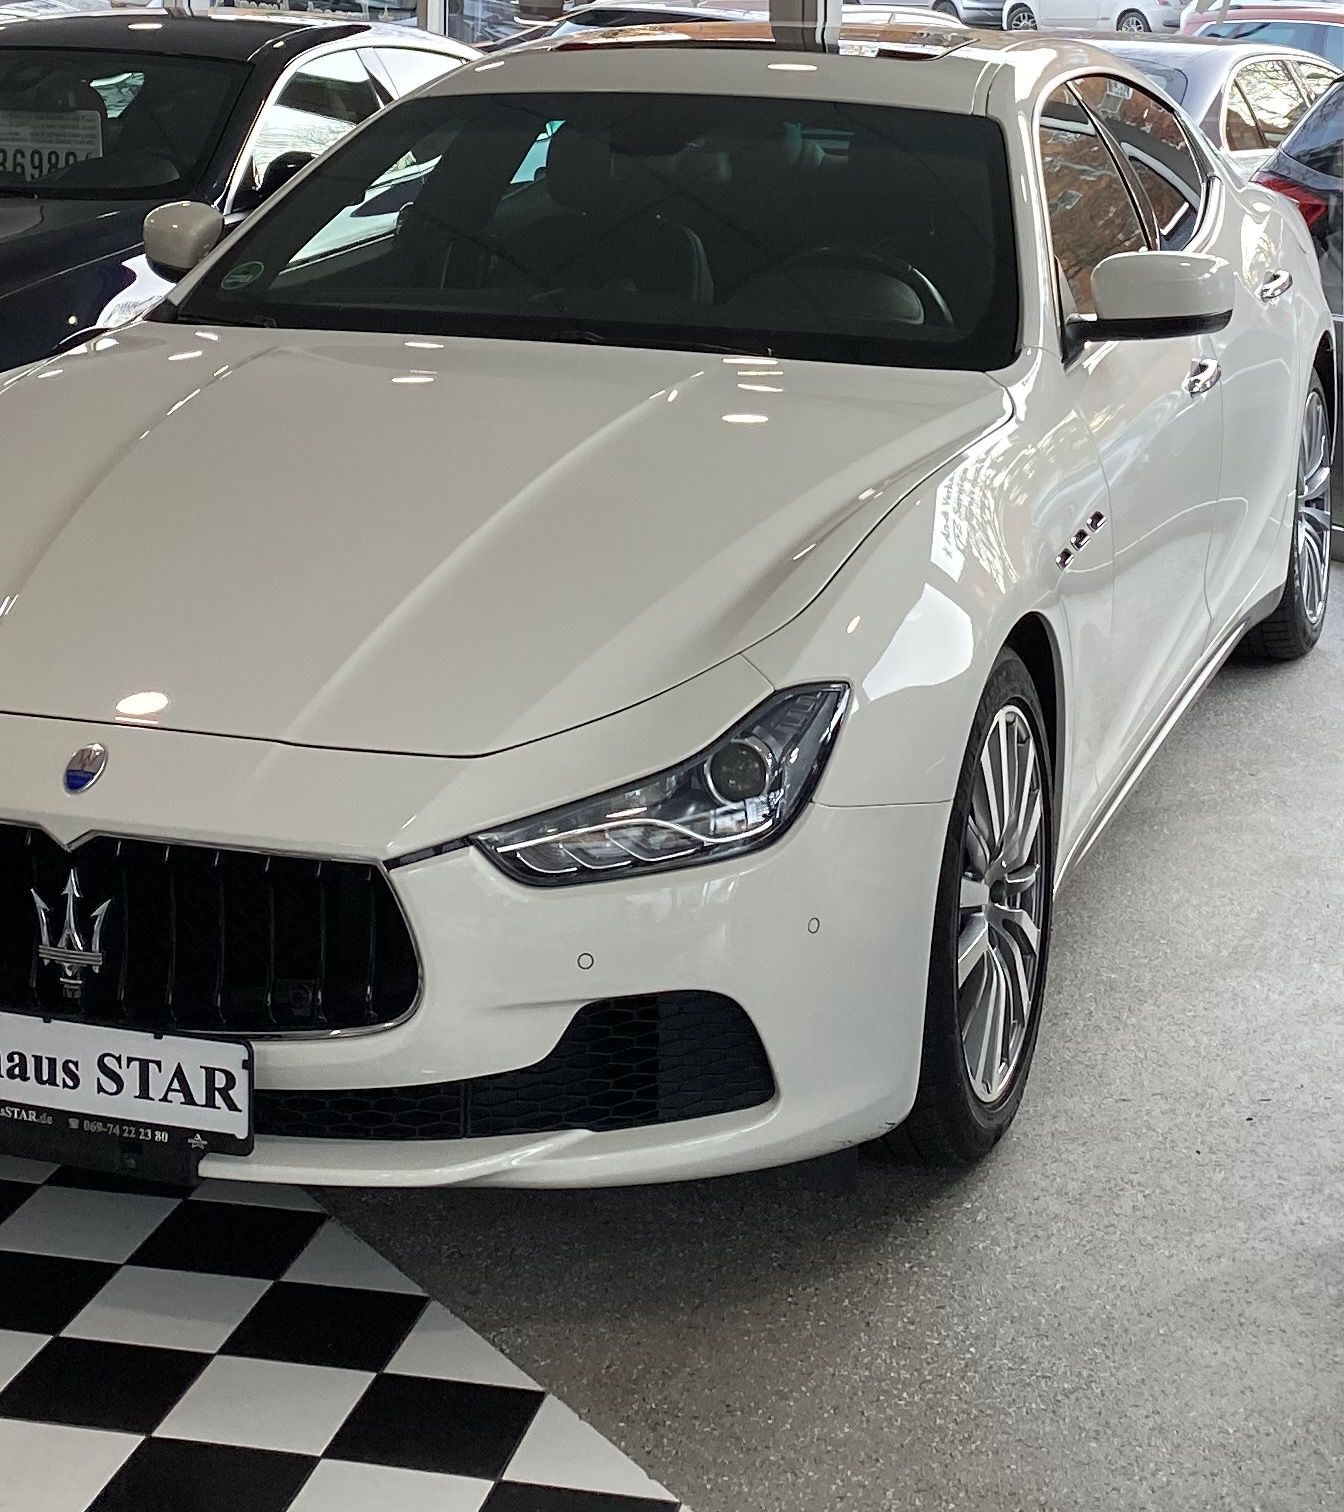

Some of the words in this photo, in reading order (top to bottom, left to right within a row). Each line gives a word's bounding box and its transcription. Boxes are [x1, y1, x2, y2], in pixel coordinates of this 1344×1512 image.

[96, 1052, 243, 1113] STAR
[122, 1126, 136, 1138] 22
[139, 1128, 152, 1141] 23
[154, 1131, 169, 1143] 80
